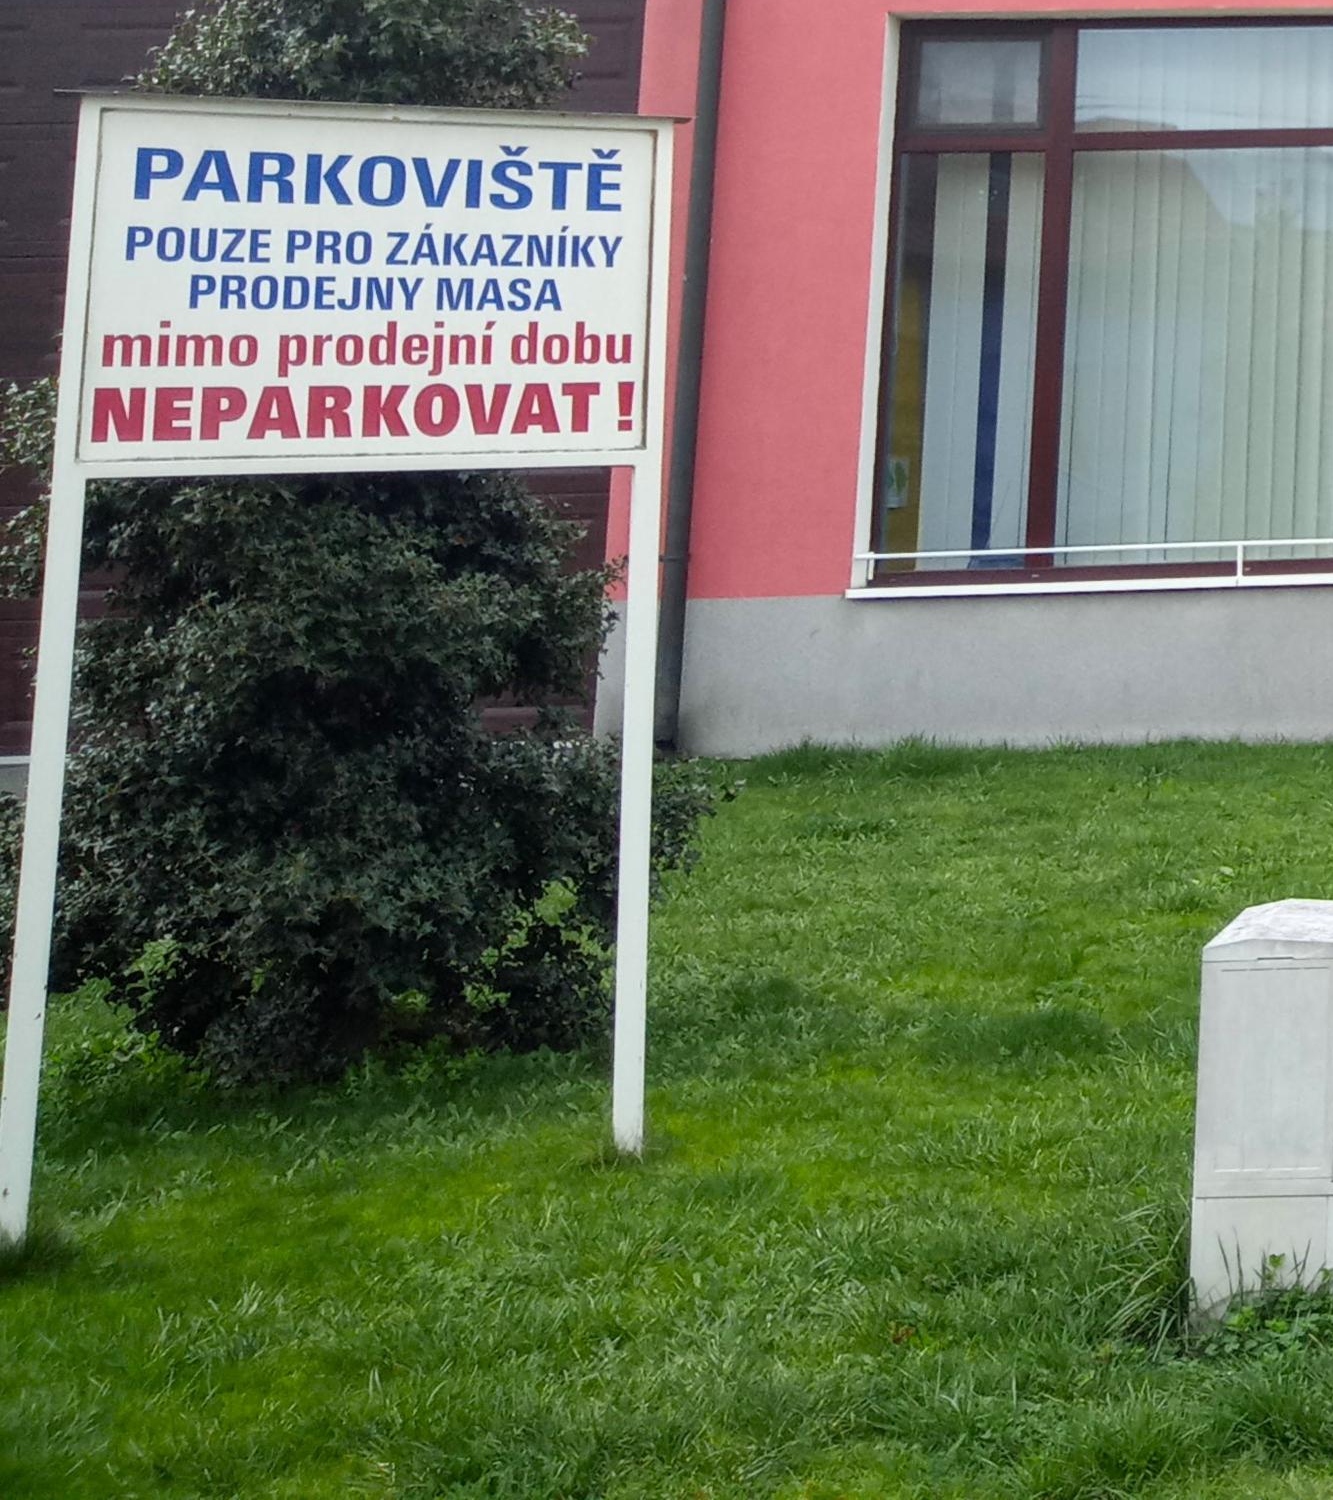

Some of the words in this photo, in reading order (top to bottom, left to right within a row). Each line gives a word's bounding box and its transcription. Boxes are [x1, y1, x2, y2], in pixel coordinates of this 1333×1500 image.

[133, 145, 624, 212] PARKOVIŠTĚ
[125, 225, 271, 263] POUZE
[285, 229, 373, 265] PRO
[385, 222, 624, 268] ZÁKAZNÍKY
[188, 274, 424, 311] PRODEJNY
[435, 277, 563, 312] MASA
[101, 320, 259, 368] mimo
[277, 320, 496, 378] prodejní
[510, 321, 633, 366] dobu
